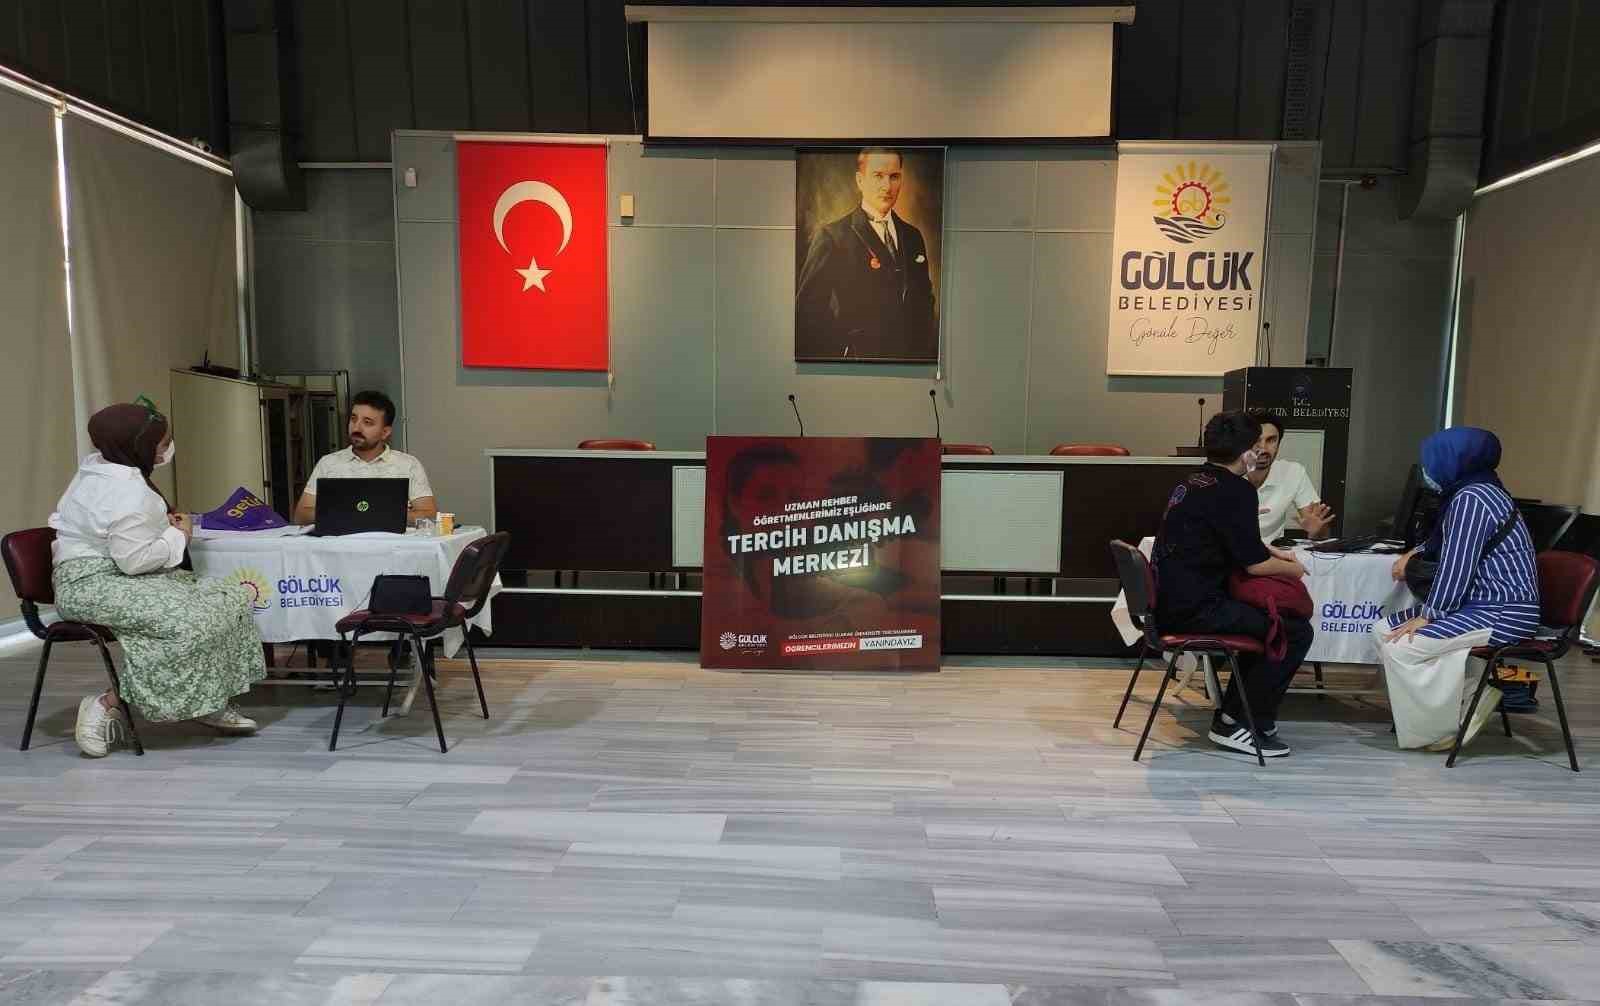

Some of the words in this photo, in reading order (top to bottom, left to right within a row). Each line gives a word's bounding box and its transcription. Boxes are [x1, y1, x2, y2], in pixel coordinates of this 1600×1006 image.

[1121, 250, 1254, 290] GÖLCÜK
[1119, 294, 1253, 311] BELEDİYESİ
[1184, 316, 1238, 356] Değer
[784, 501, 820, 512] UZMAN
[821, 495, 858, 508] REHBER
[753, 508, 842, 526] ÖĞRETMENLERİMİZ
[843, 502, 893, 515] EŞLİĞİNDE
[728, 525, 807, 554] TERCİH
[813, 515, 916, 543] DANIŞMA
[773, 543, 869, 577] MERKEZİ
[278, 575, 342, 593] GÖLCÜK
[280, 594, 344, 608] BELEDİYESİ
[1323, 602, 1386, 619] GÖLCÜK
[1321, 622, 1374, 633] BELEDİYE
[864, 638, 916, 647] YANINDAYIZ
